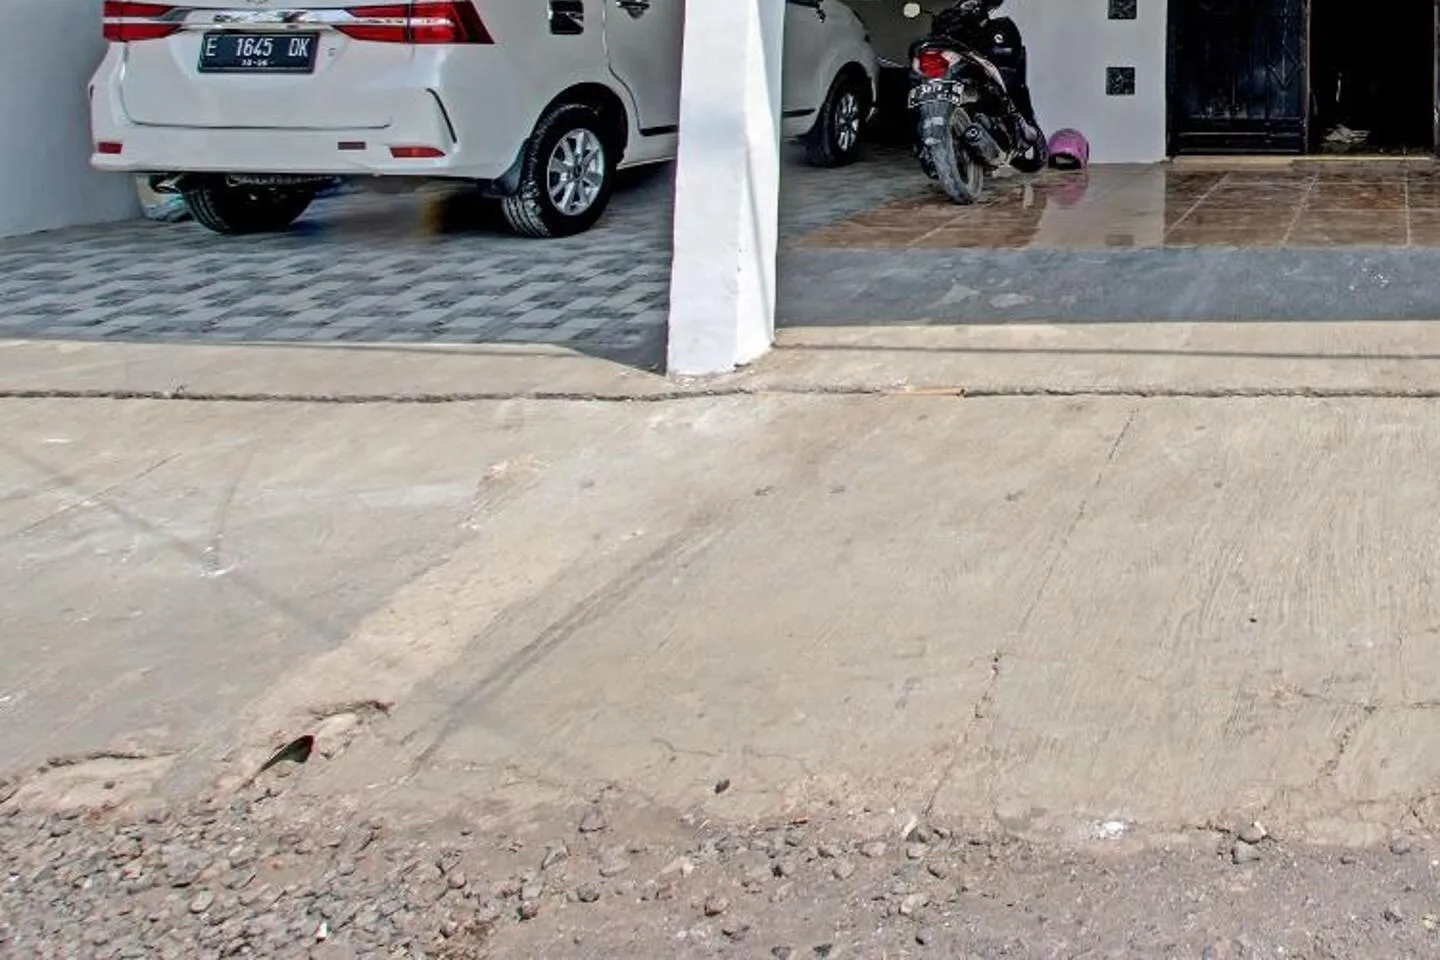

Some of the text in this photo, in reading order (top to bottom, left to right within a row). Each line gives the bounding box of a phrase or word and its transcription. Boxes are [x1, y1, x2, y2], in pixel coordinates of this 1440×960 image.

[205, 38, 311, 57] E 1645 DK
